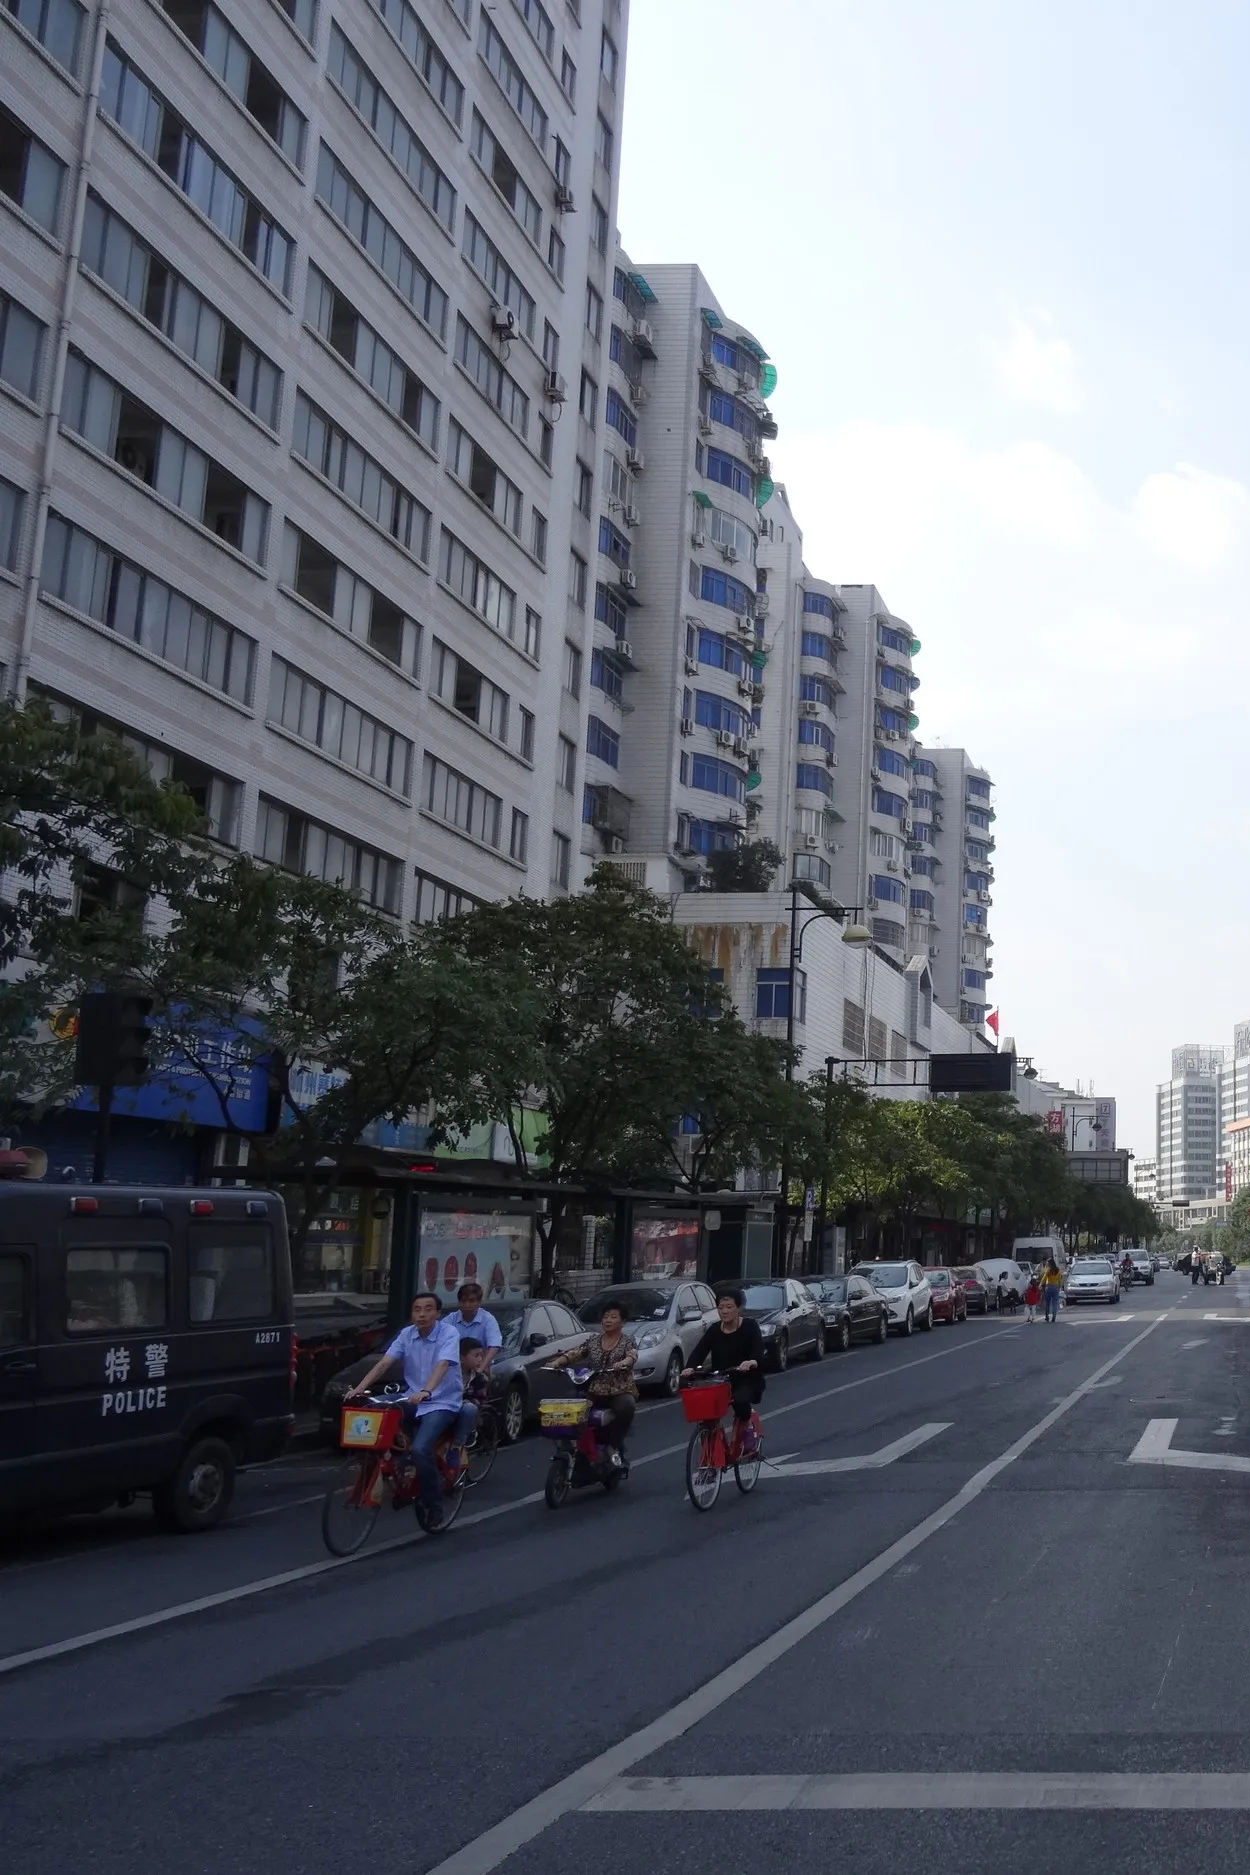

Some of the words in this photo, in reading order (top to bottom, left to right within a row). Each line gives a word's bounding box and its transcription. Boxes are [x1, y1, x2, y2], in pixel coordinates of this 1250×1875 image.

[255, 1331, 281, 1344] A2871
[104, 1342, 169, 1384] 特警
[101, 1385, 167, 1417] POLICE
